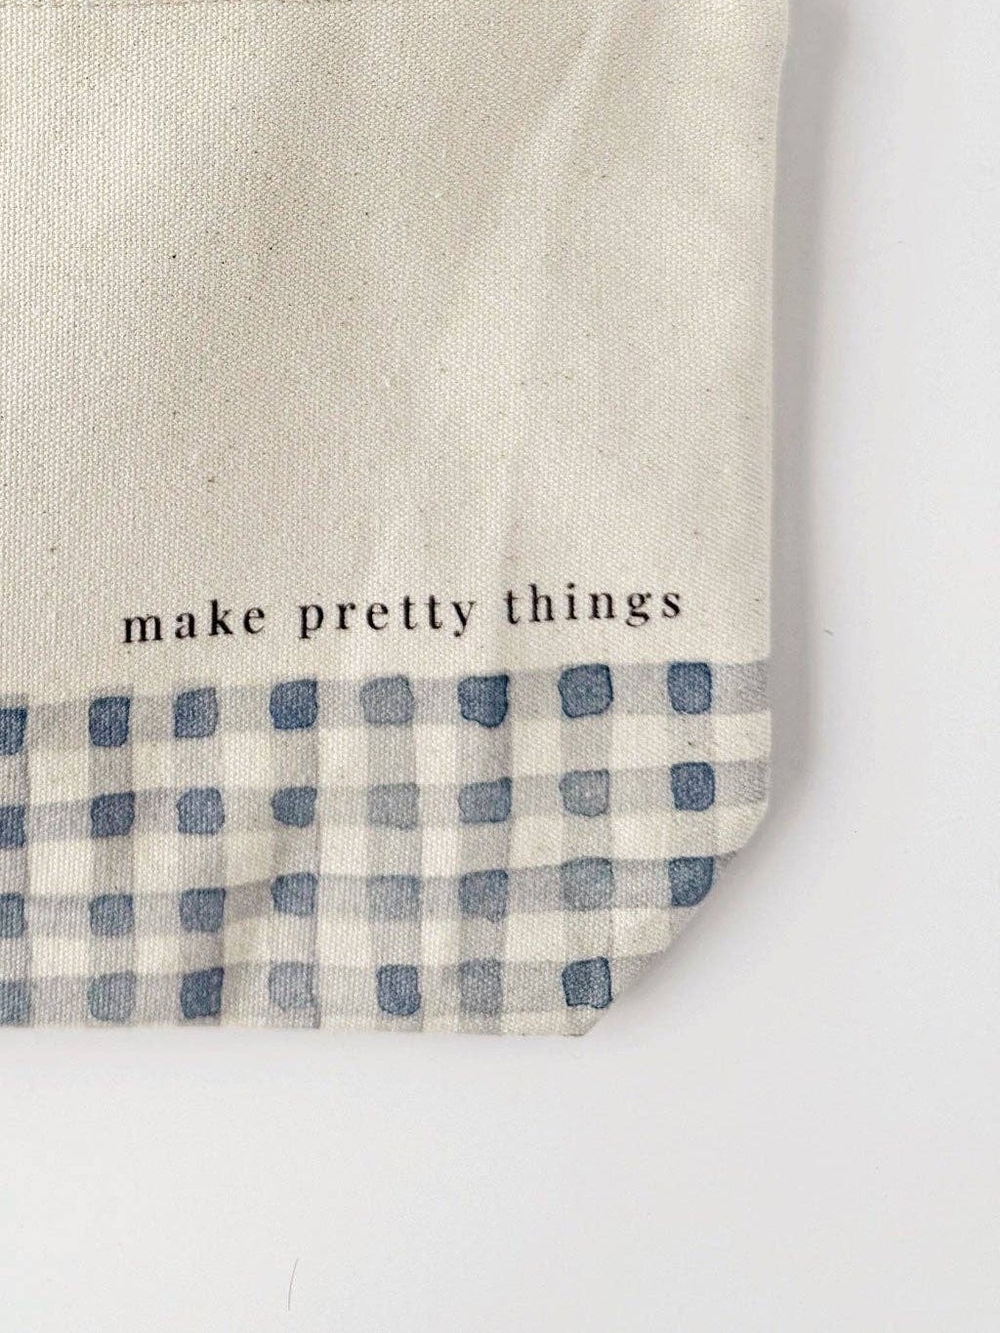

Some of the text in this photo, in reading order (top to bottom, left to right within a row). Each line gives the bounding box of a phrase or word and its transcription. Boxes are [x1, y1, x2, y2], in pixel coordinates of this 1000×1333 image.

[121, 581, 683, 645] make pretty things
